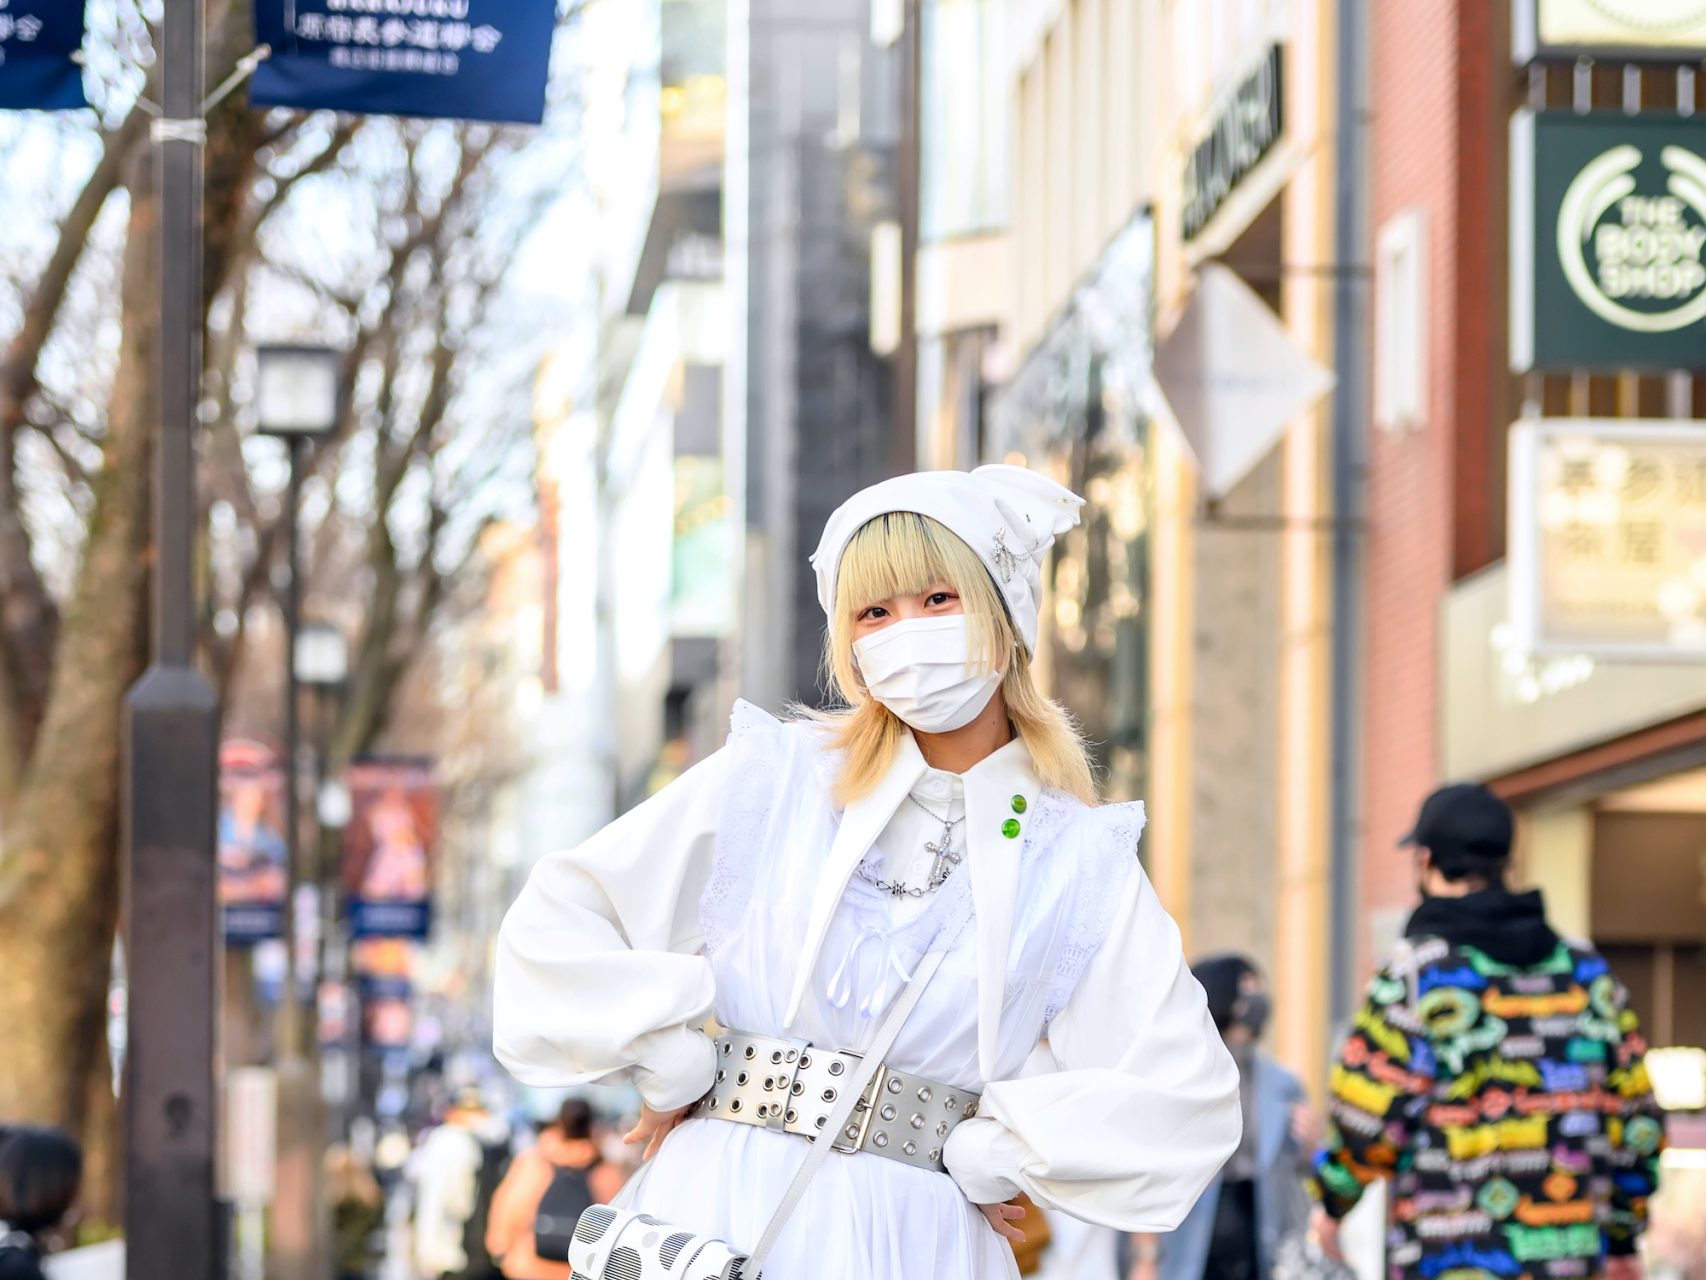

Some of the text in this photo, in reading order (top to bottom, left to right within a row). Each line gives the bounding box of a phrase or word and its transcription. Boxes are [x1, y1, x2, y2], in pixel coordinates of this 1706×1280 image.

[1617, 196, 1686, 229] THE
[1595, 223, 1706, 266] BODY
[1598, 260, 1706, 299] SHOP
